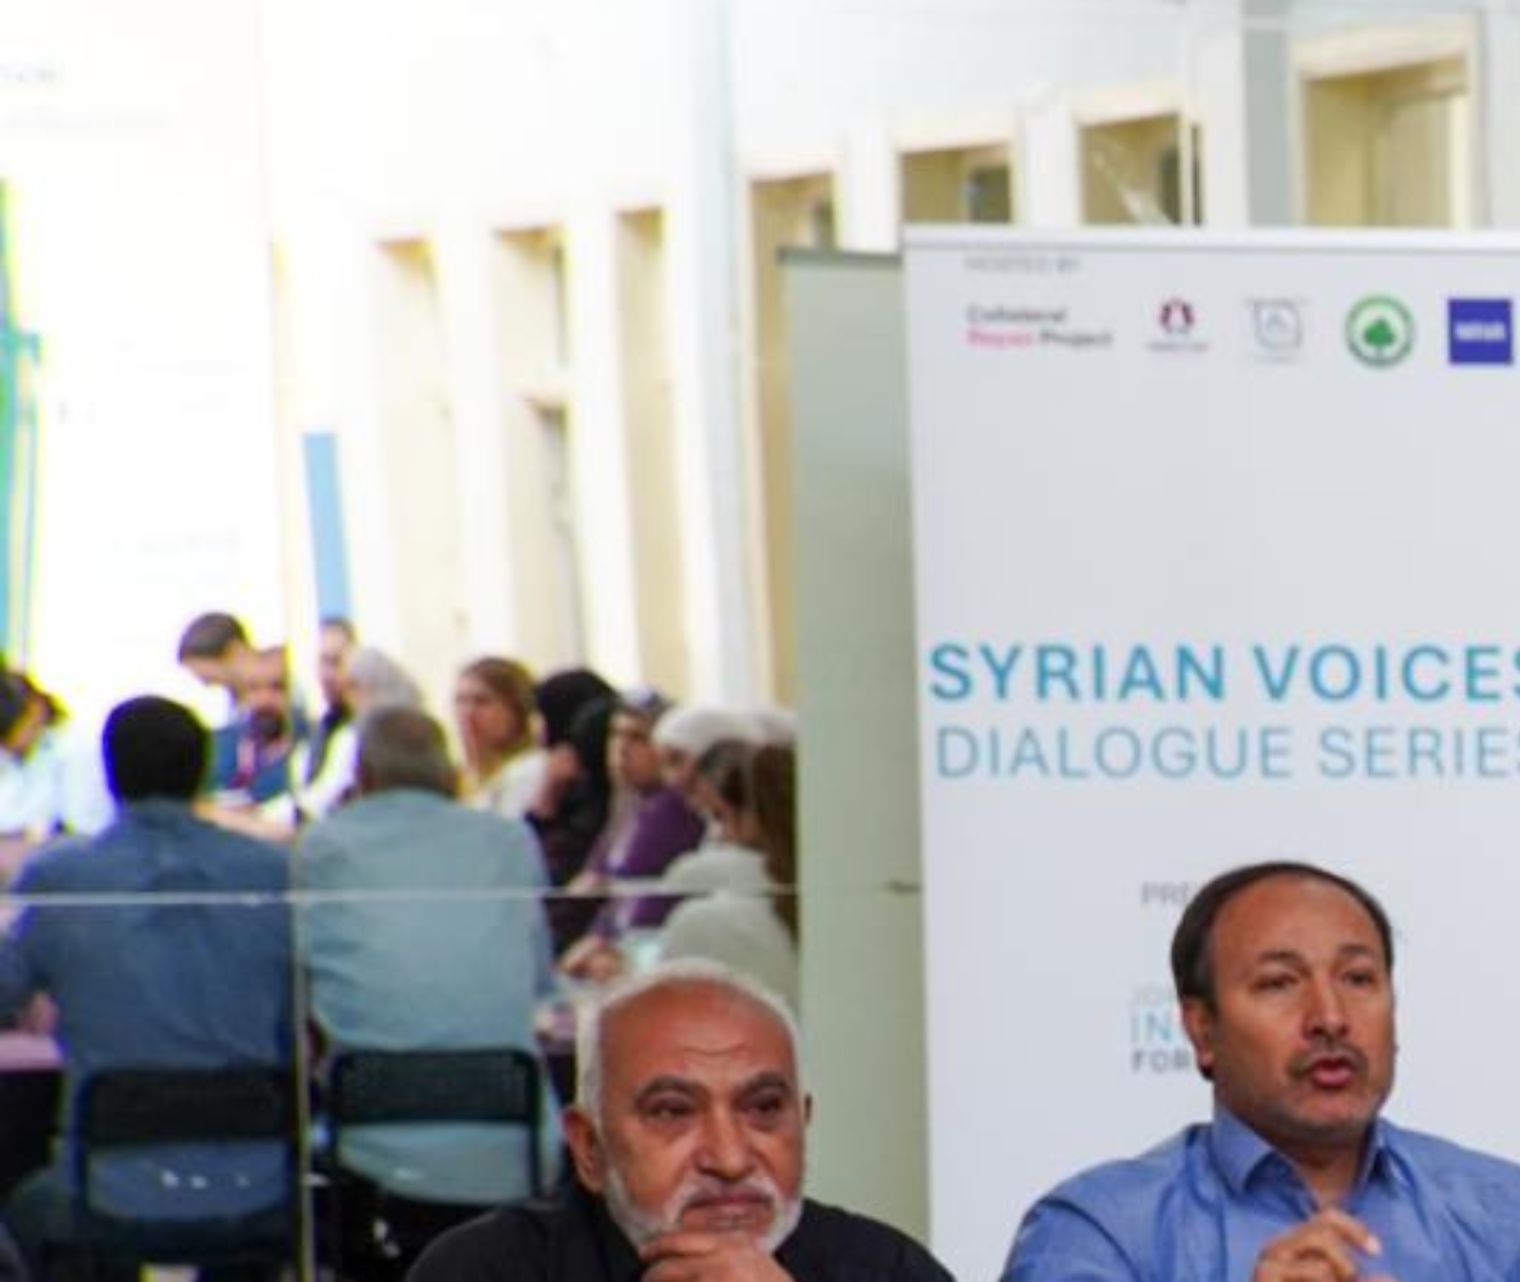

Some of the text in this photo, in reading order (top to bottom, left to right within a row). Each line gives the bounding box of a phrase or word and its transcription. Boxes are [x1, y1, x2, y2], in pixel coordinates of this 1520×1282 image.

[1039, 328, 1112, 351] Project
[930, 643, 1225, 702] SYRIAN
[935, 725, 1293, 780] DIALOGUE
